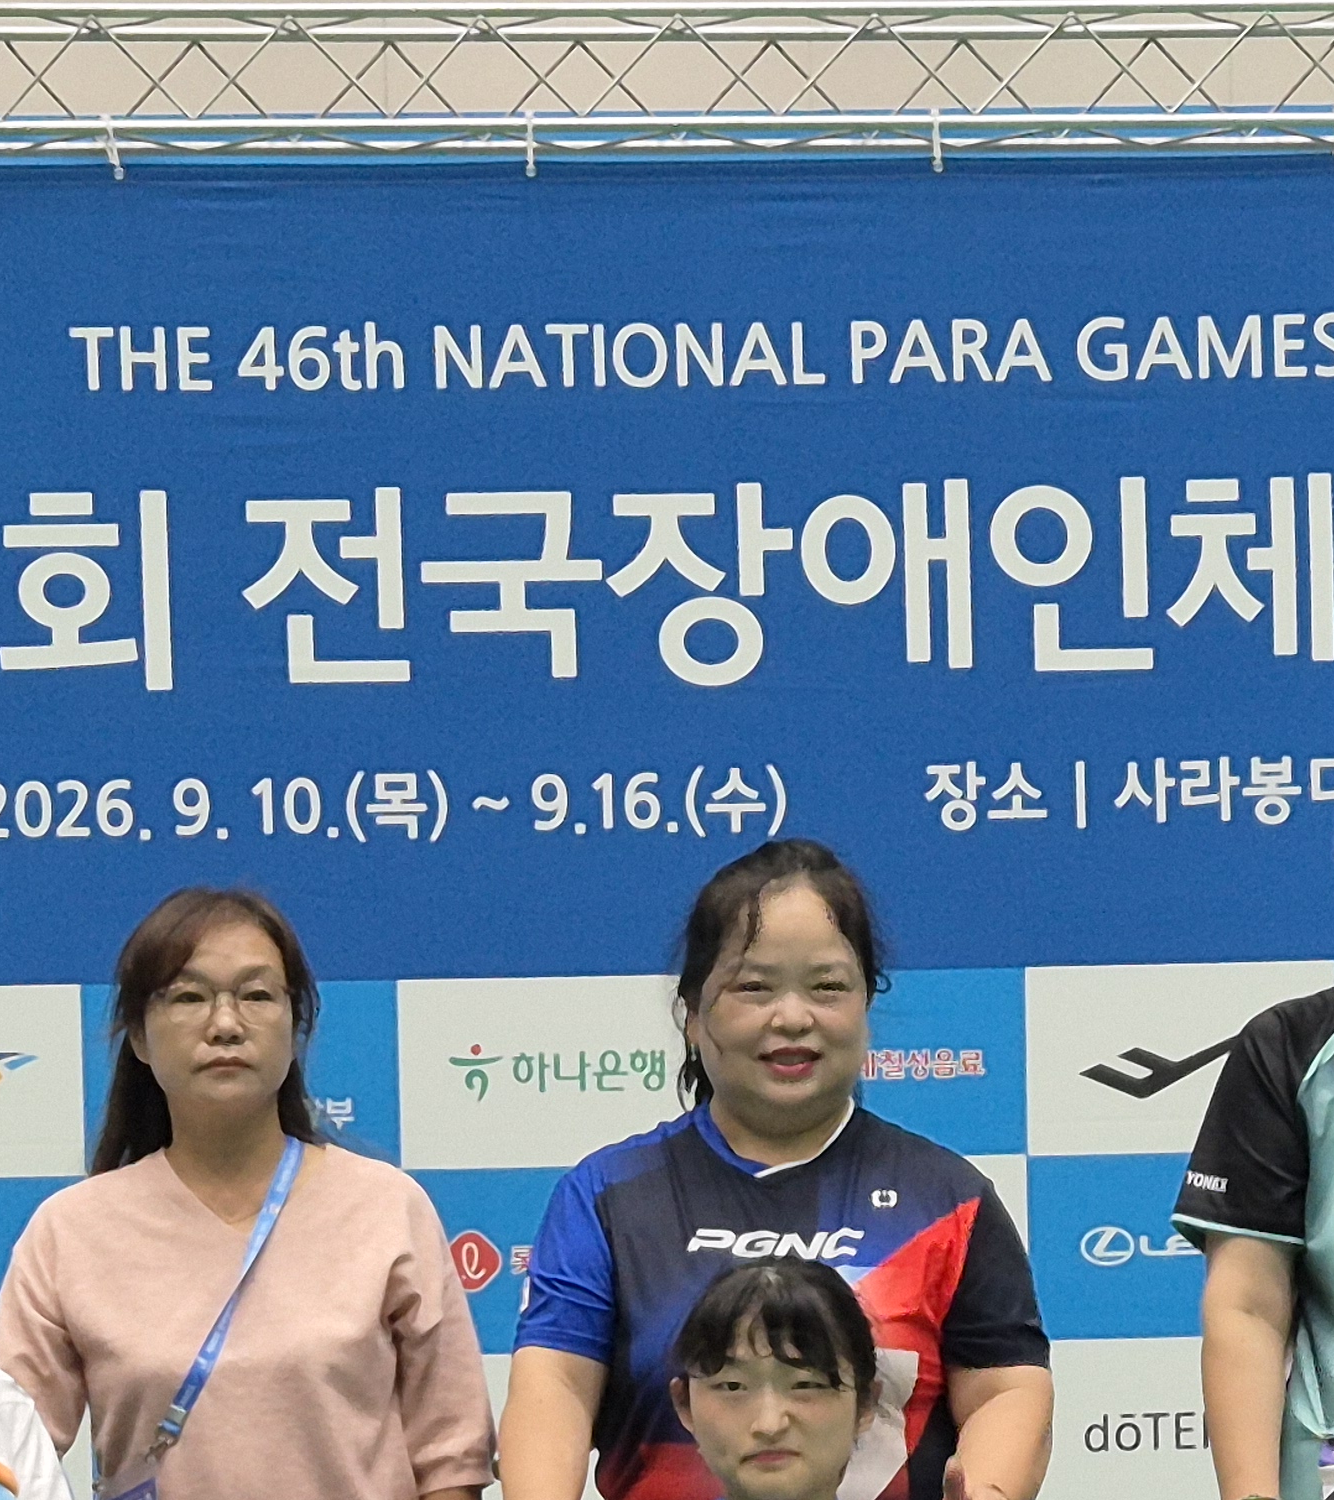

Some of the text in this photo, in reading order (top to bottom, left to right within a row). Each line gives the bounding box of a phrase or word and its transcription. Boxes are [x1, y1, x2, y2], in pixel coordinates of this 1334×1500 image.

[68, 325, 213, 392] THE
[237, 320, 405, 392] 46th
[433, 321, 826, 390] NATIONAL
[850, 318, 1053, 385] PARA
[172, 777, 229, 840] 9.
[251, 769, 448, 843] 10.(목)
[531, 763, 788, 840] 9.16.(수)
[924, 760, 1048, 832] 장소
[509, 1046, 667, 1094] 하나은행
[863, 1049, 986, 1081] 칠성음료
[1186, 1170, 1229, 1193] YONEX
[1083, 1410, 1208, 1453] dōTE
